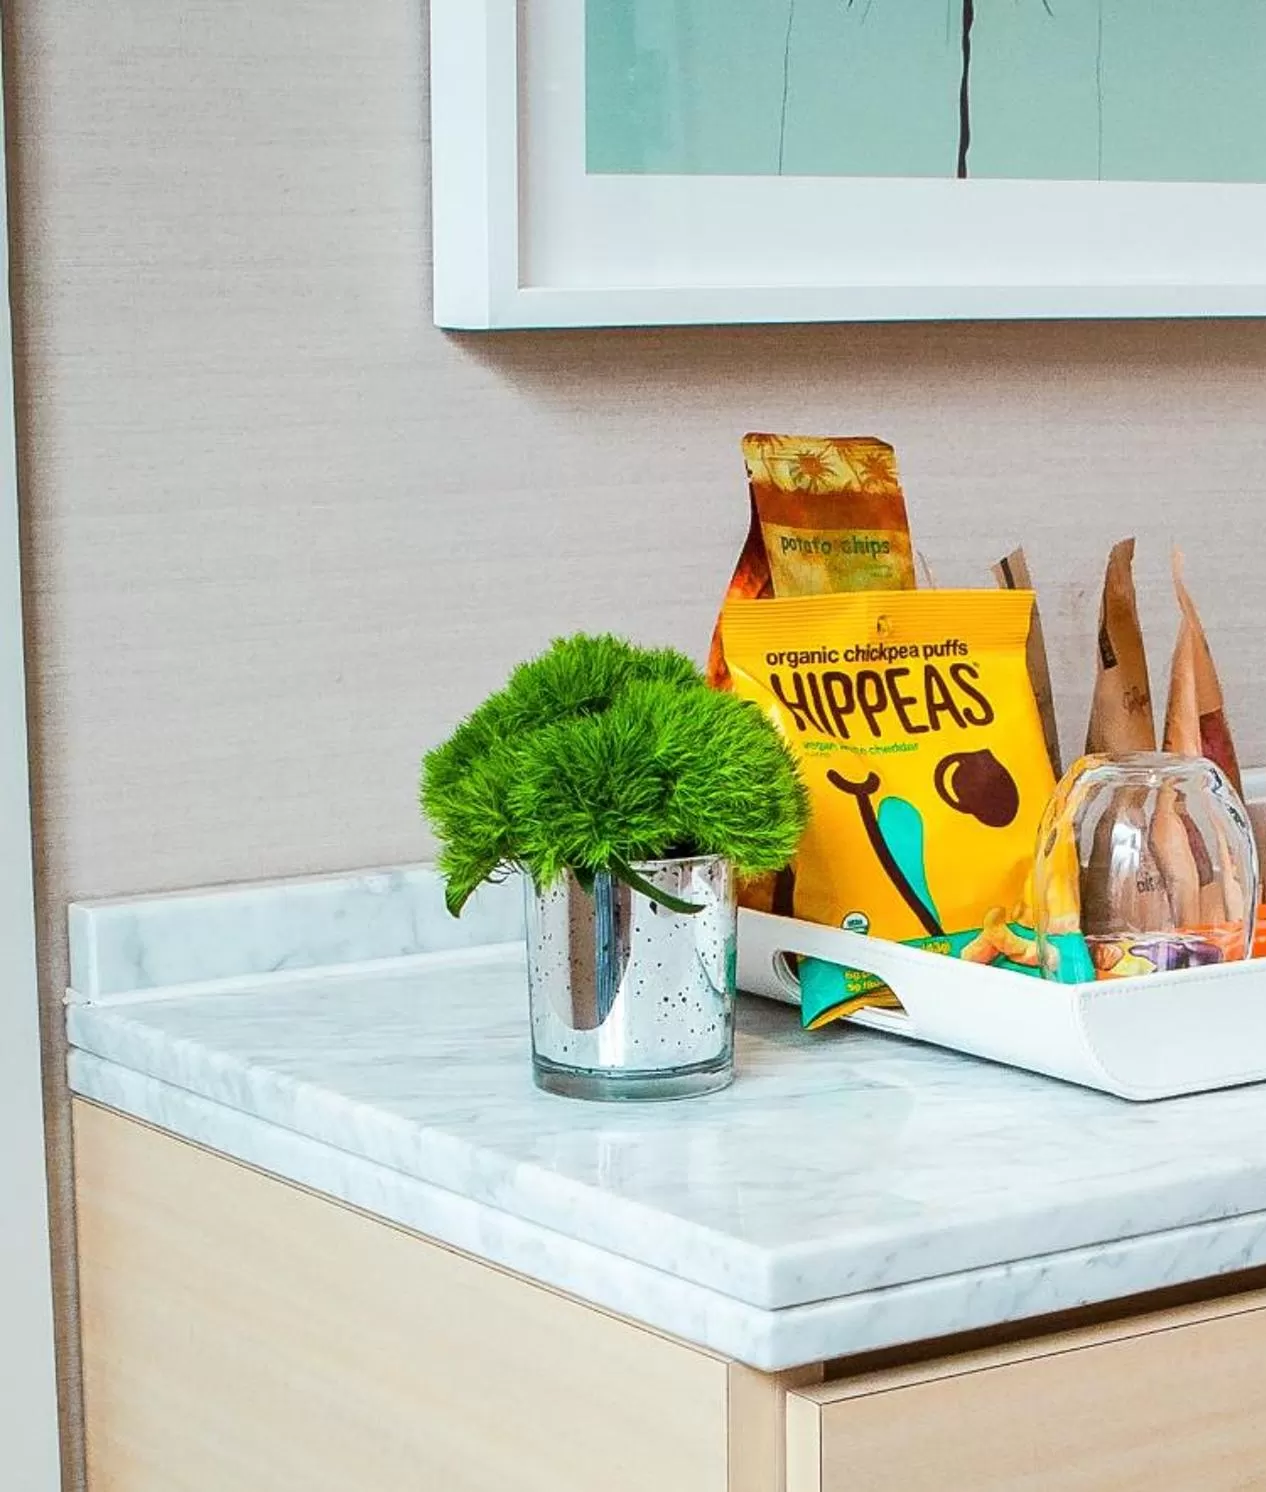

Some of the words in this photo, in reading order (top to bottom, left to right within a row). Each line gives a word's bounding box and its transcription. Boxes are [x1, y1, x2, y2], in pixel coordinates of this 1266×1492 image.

[780, 536, 832, 556] potato
[841, 535, 890, 559] chips
[766, 646, 840, 668] organic
[843, 643, 919, 663] chickpea
[922, 639, 968, 660] puffs
[770, 663, 994, 739] HIPPEAS
